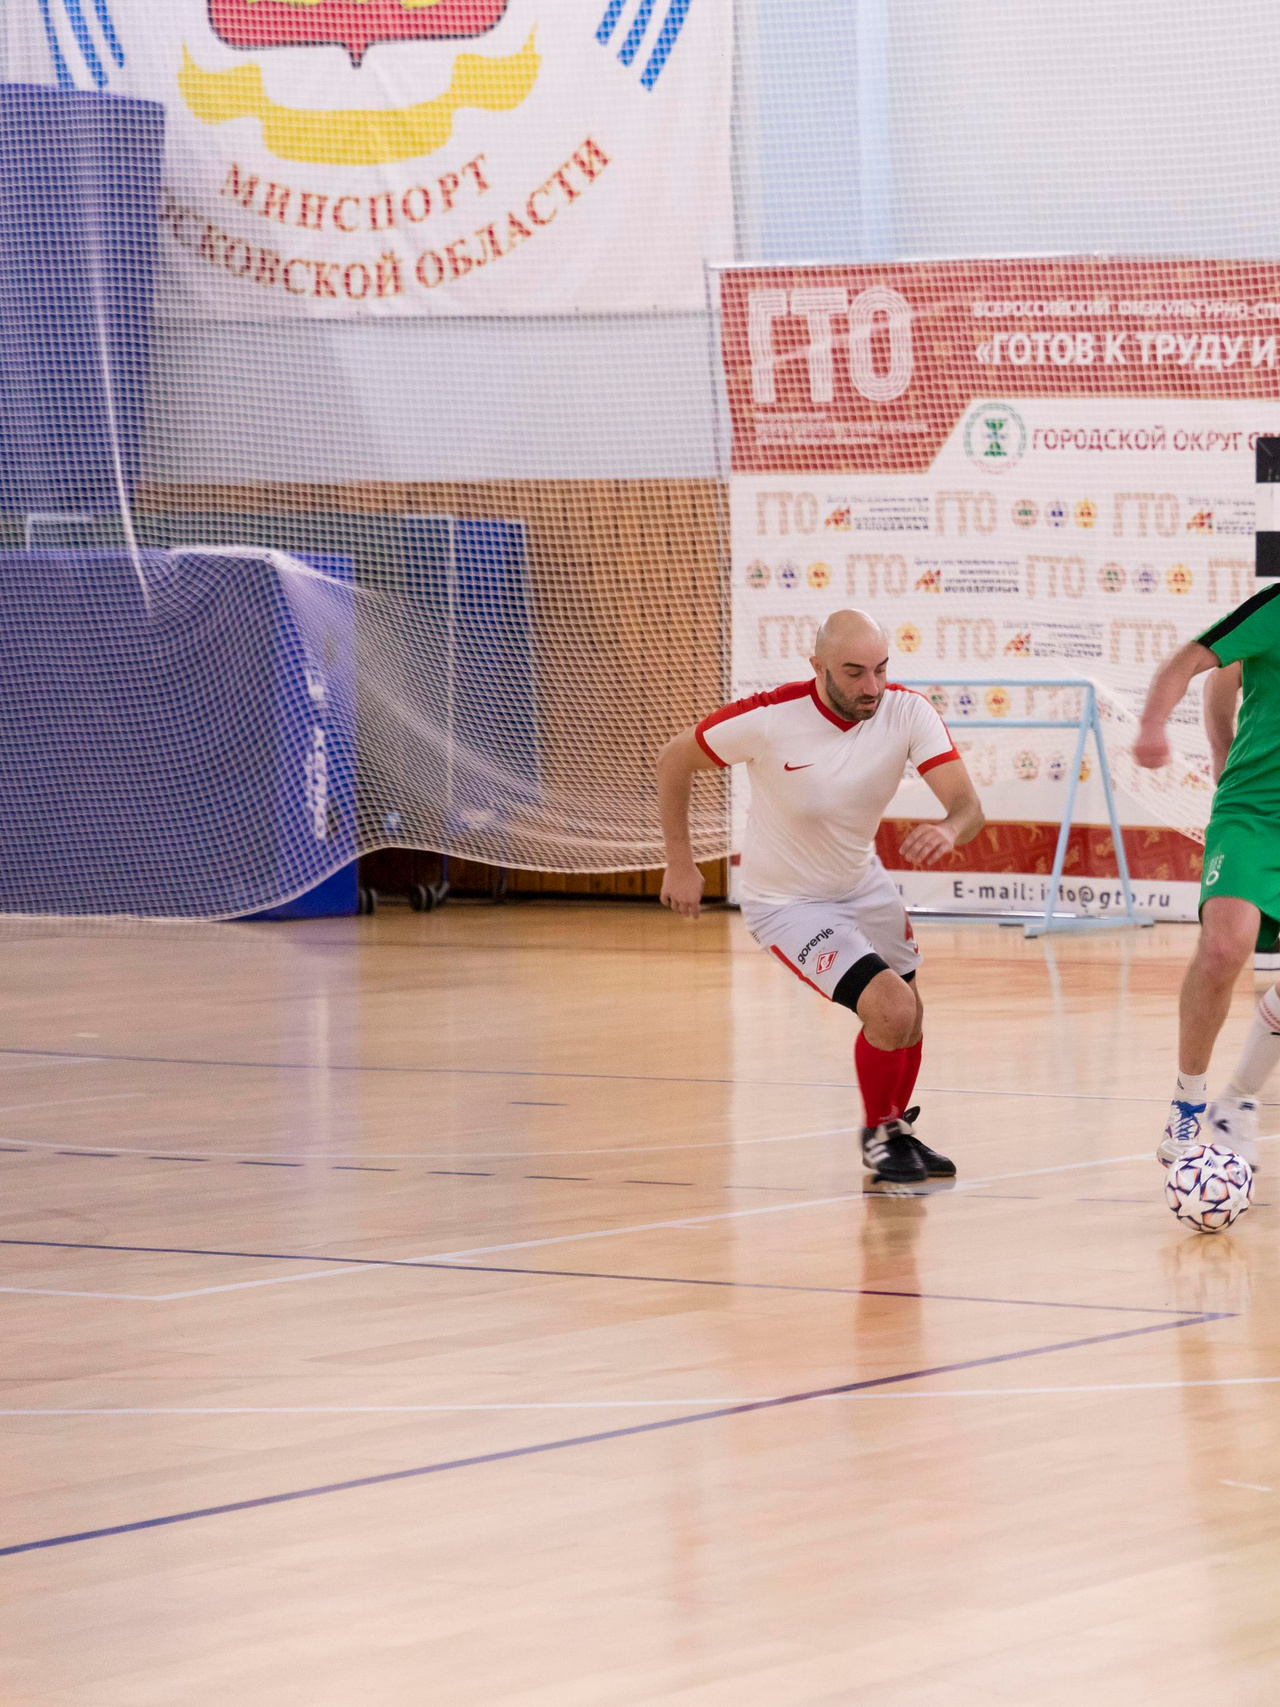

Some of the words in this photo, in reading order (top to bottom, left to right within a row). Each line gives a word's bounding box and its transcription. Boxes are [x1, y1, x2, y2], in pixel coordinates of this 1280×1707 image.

[220, 152, 491, 233] МИНСПОРТ
[415, 134, 613, 289] ОБЛАСТИ
[750, 287, 914, 402] ГТО
[974, 331, 1095, 367] «ГОТОВ
[1105, 331, 1127, 364] К
[1135, 332, 1244, 373] ТРУДУ
[1252, 335, 1276, 368] И
[1032, 423, 1167, 453] ГОРОДСКОЙ
[1172, 430, 1243, 453] ОКРУГ
[953, 881, 1034, 901] E-mail:
[797, 926, 834, 966] gorenje
